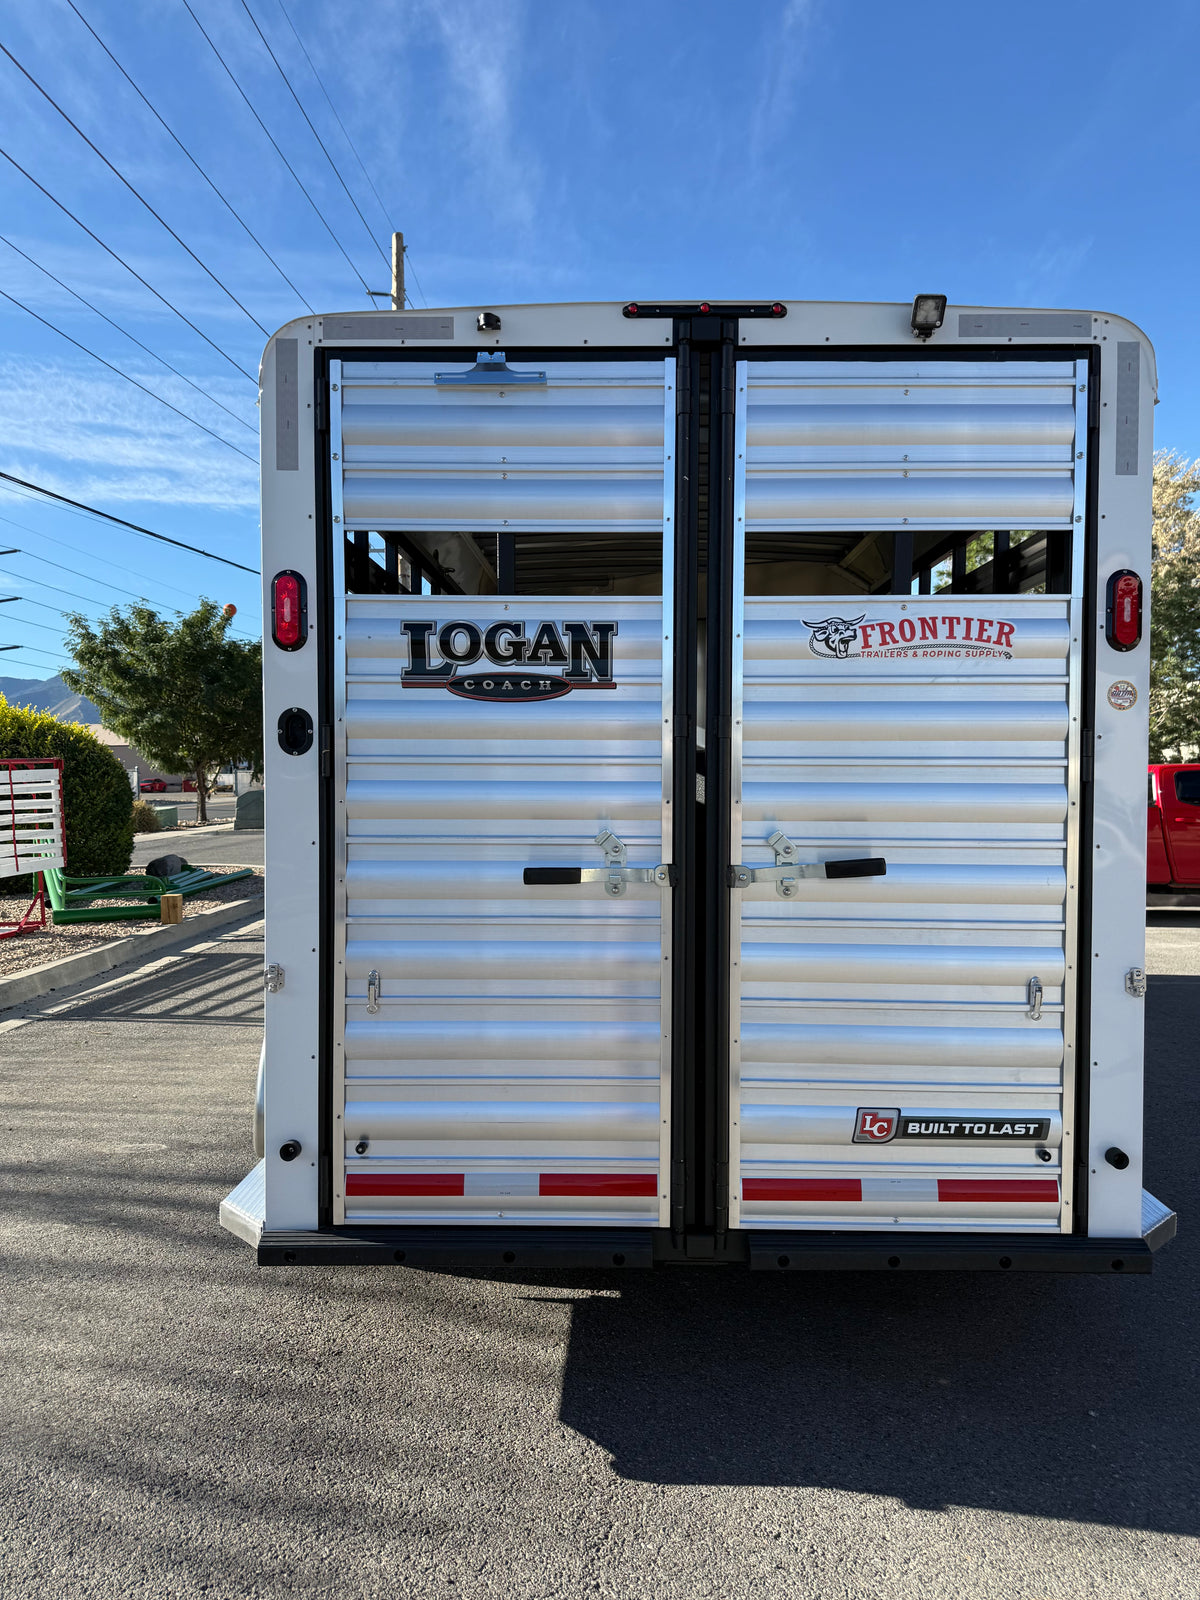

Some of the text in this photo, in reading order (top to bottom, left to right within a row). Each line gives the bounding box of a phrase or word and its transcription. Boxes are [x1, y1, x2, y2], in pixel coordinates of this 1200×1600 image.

[859, 616, 1016, 649] FRONTIER
[401, 620, 618, 681] LOGAN
[861, 650, 1003, 658] TRAILERS & ROPING SUPPLY
[464, 680, 551, 690] COACH
[863, 1115, 888, 1137] LC
[907, 1122, 1038, 1135] BUILT TO LAST
